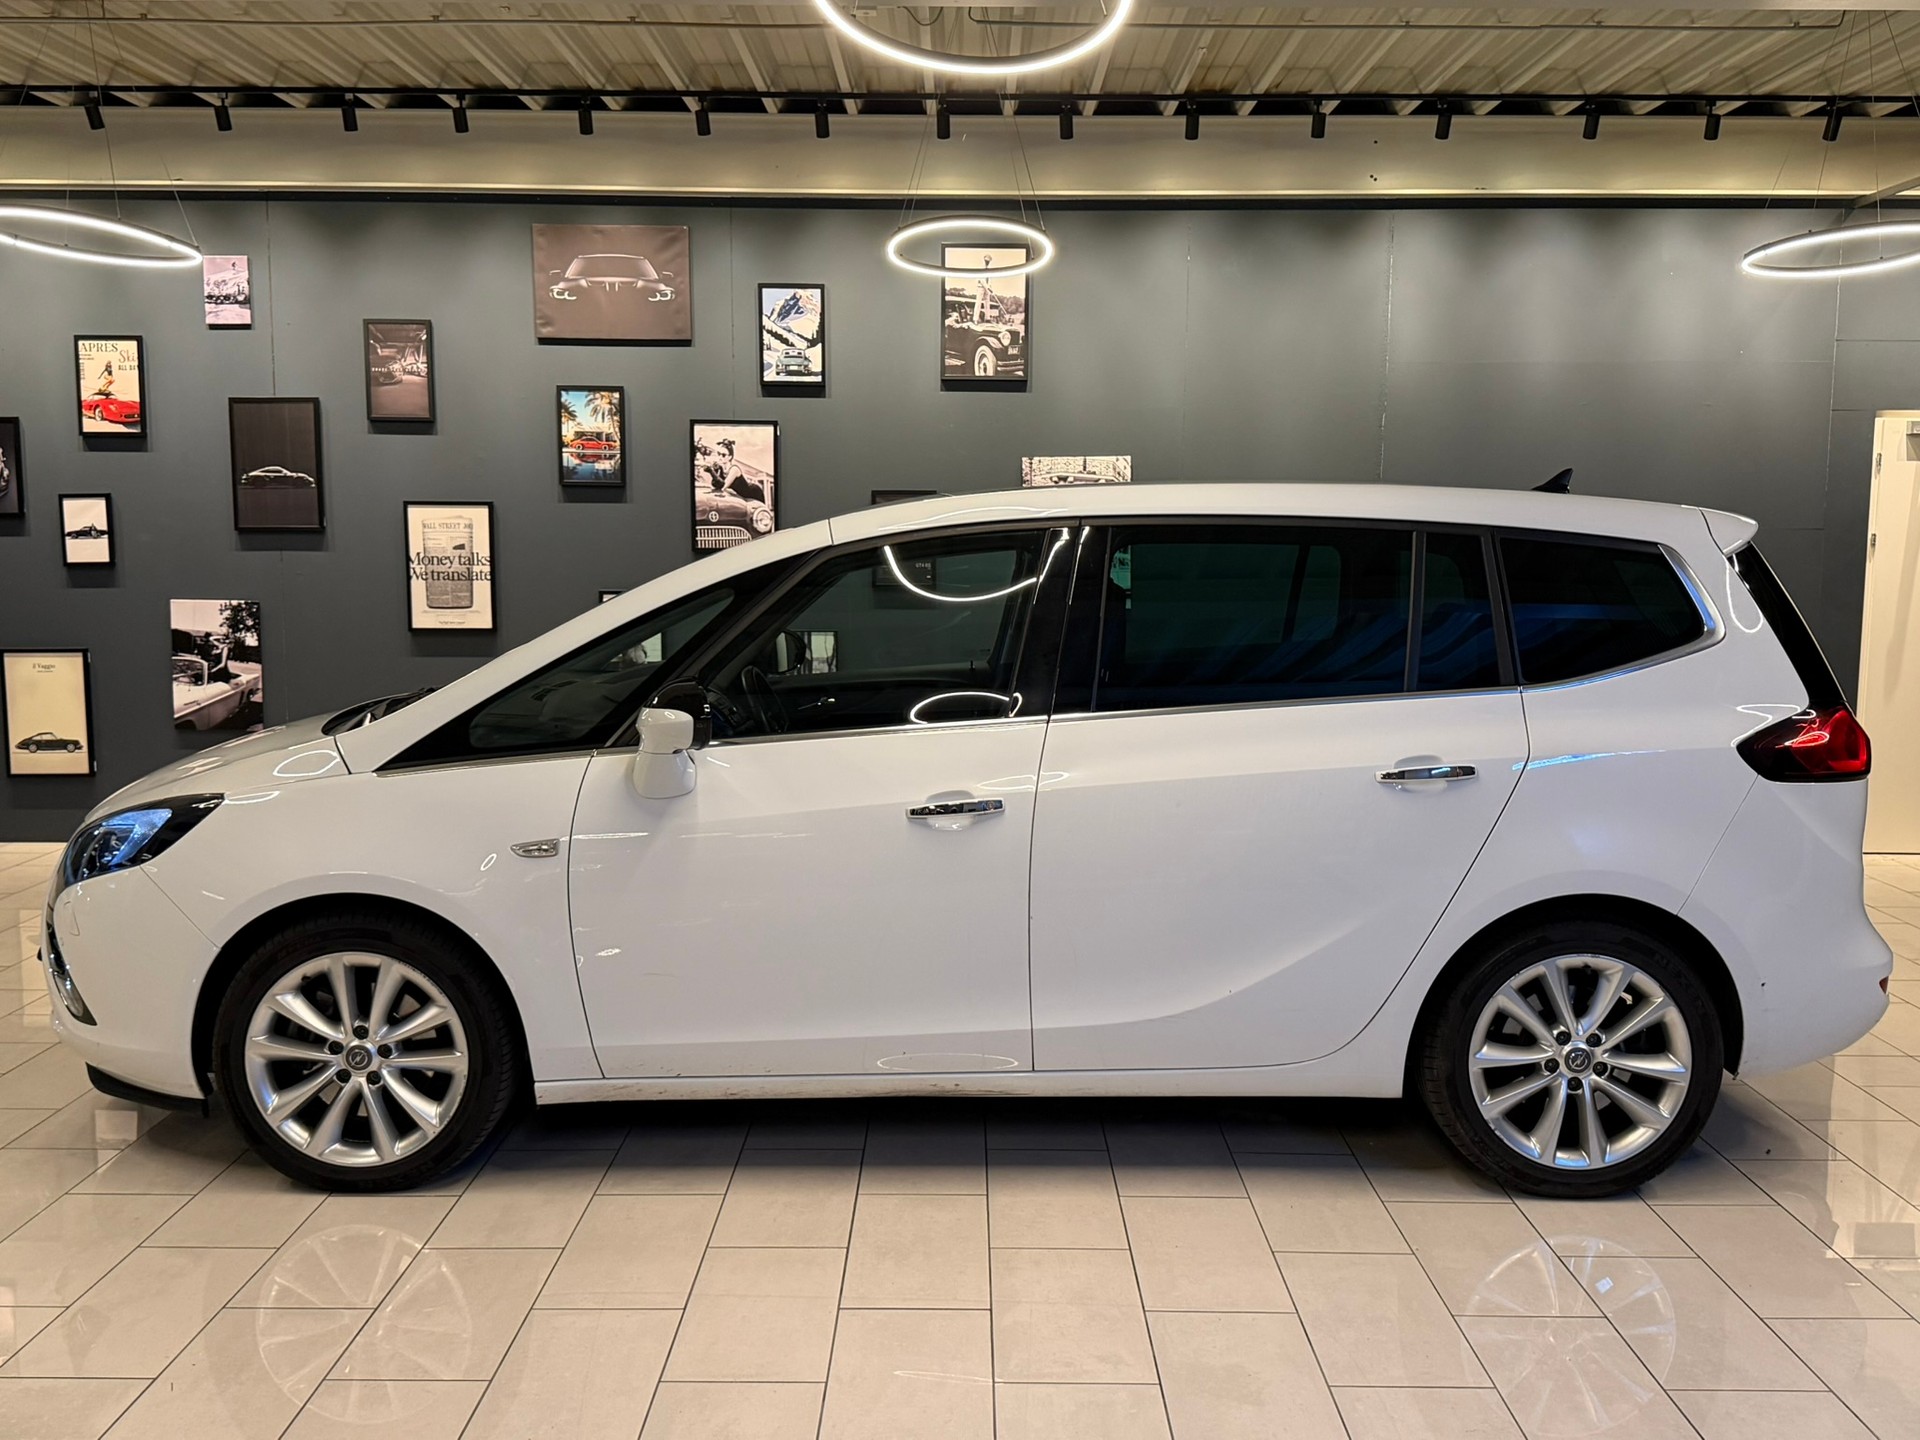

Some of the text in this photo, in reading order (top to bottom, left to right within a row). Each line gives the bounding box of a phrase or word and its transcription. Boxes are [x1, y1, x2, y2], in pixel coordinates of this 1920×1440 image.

[118, 349, 136, 363] Ski
[458, 551, 491, 566] talks
[430, 567, 492, 581] translate
